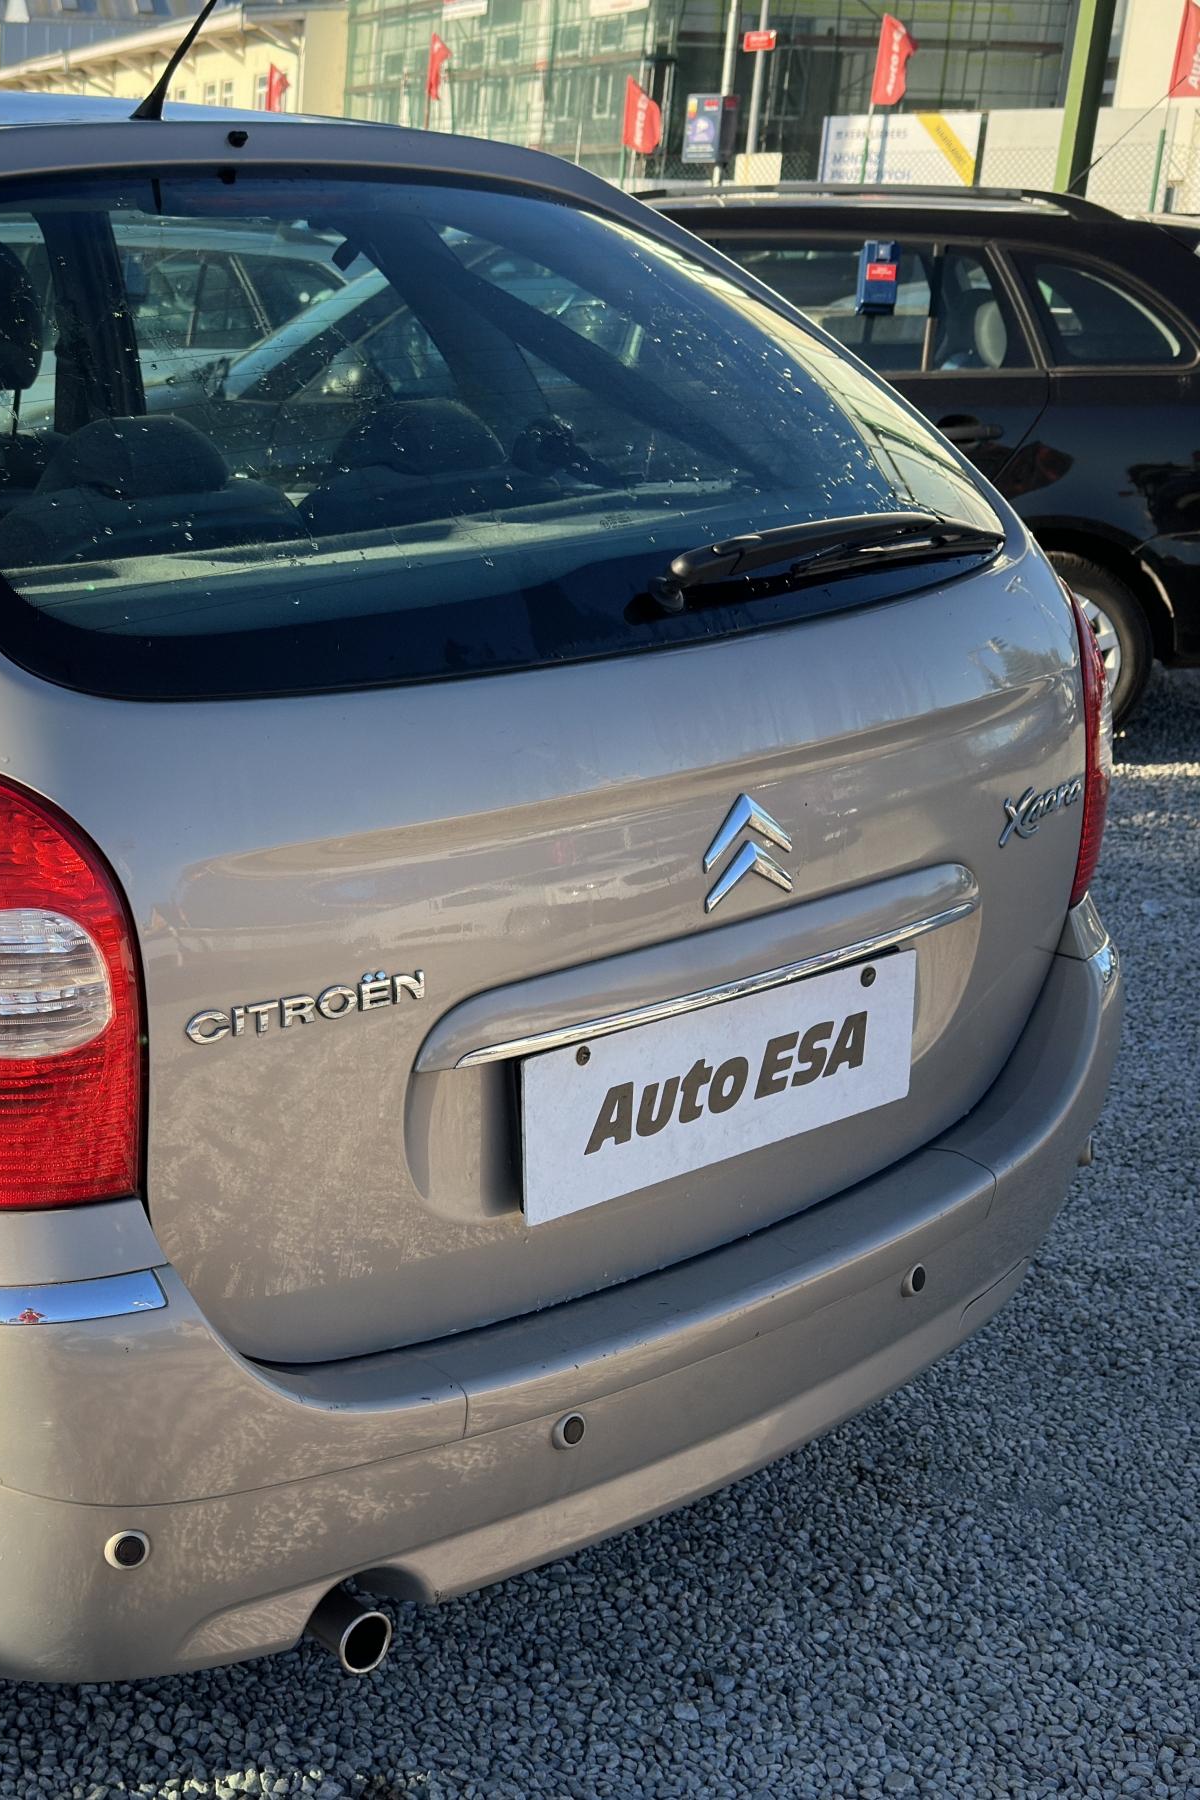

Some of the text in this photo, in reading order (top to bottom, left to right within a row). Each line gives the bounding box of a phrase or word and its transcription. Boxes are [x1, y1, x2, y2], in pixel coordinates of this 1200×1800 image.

[185, 969, 425, 1045] CITROËN
[584, 1010, 868, 1156] Auto ESA
